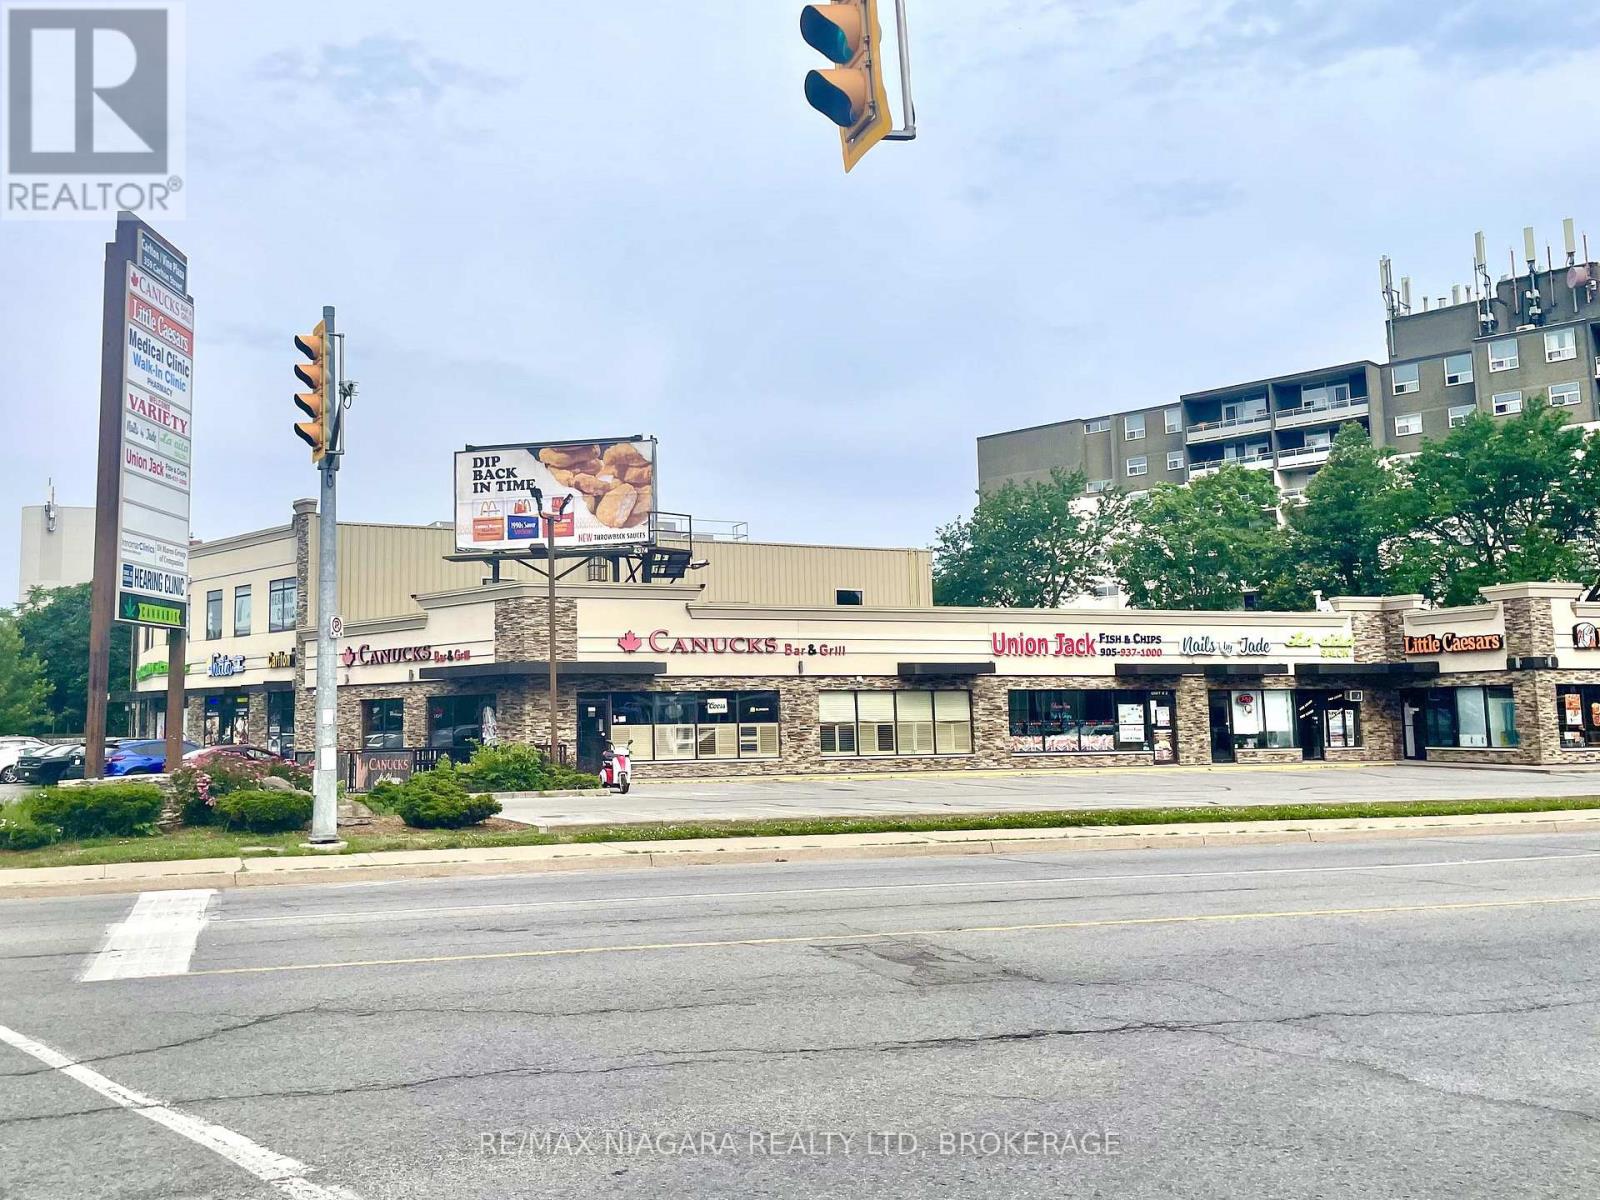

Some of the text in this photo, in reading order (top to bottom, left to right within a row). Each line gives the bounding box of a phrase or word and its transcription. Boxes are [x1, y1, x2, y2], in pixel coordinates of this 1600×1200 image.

[139, 276, 180, 316] CANUCKS
[132, 298, 156, 332] Little
[156, 315, 189, 353] Caesars
[129, 328, 190, 379] Medical Clinic
[133, 351, 186, 393] Walk-In Clinic
[147, 377, 173, 398] PHARMACY
[128, 394, 188, 435] VARIETY
[126, 447, 147, 473] Union
[149, 457, 165, 477] Jack
[473, 456, 500, 469] DIP
[473, 468, 517, 481] BACK
[473, 479, 536, 493] IN TIME
[578, 533, 593, 542] NEW
[594, 532, 626, 541] THROWBACK
[134, 567, 163, 593] HEARING
[164, 573, 185, 597] CLINIC
[141, 606, 179, 624] CANNABIS
[648, 629, 846, 657] CANUCKS Bar & Grill
[992, 632, 1097, 656] Union Jack
[1099, 633, 1162, 644] FISH & CHIPS
[1182, 636, 1271, 653] Nails by Jade
[1403, 632, 1501, 654] Little Caesars
[358, 644, 471, 666] CANUCKS Bar & Grill
[1100, 647, 1163, 657] 905-937-1000
[1320, 649, 1349, 659] SALON
[368, 758, 409, 771] CANUCKS
